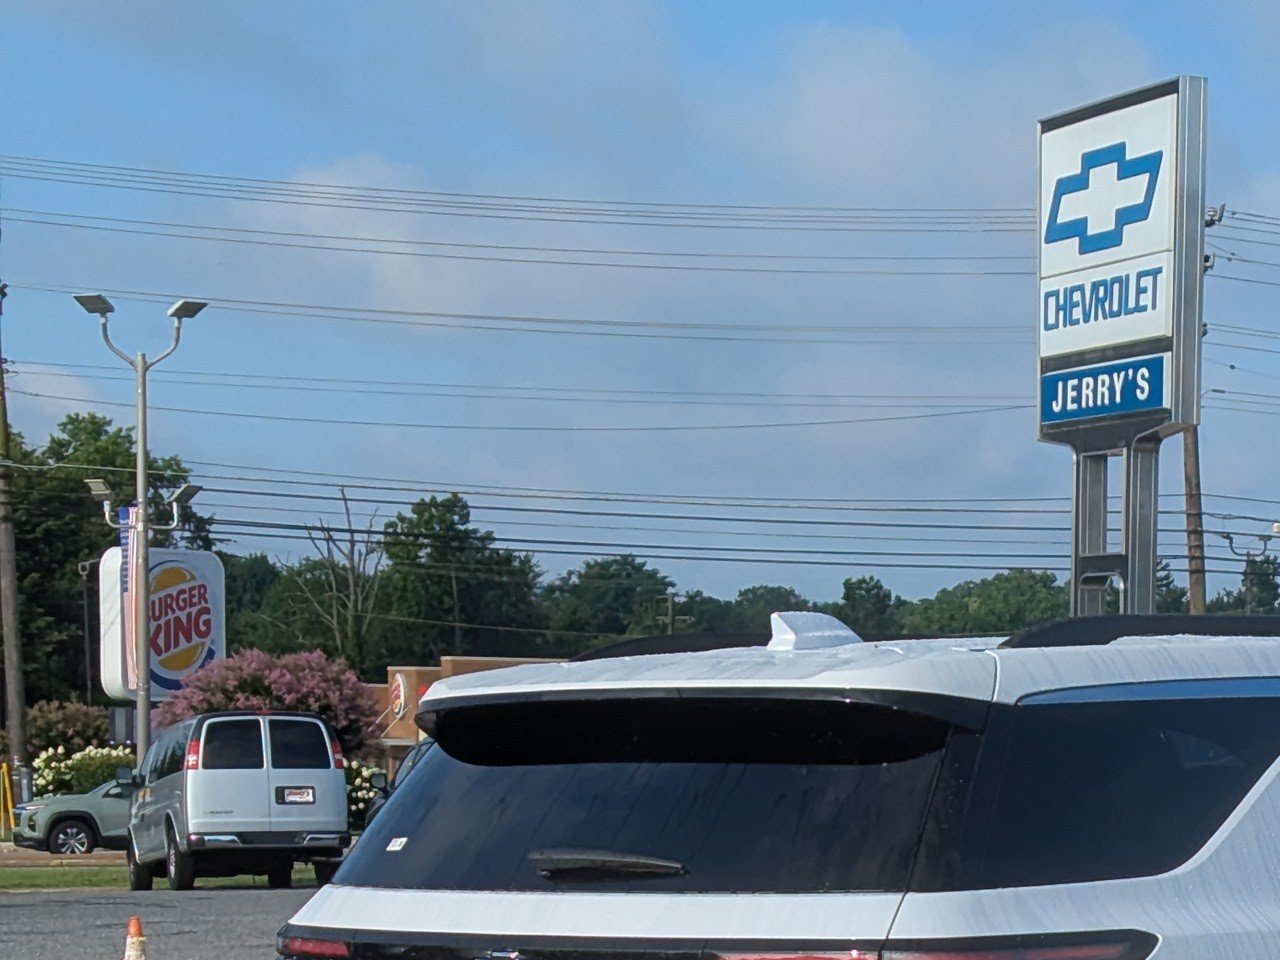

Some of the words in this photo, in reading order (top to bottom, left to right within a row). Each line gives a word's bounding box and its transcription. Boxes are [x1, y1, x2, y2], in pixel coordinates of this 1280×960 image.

[1043, 266, 1164, 332] CHEVROLET
[1051, 367, 1151, 413] JERRY'S
[149, 583, 209, 622] URGER
